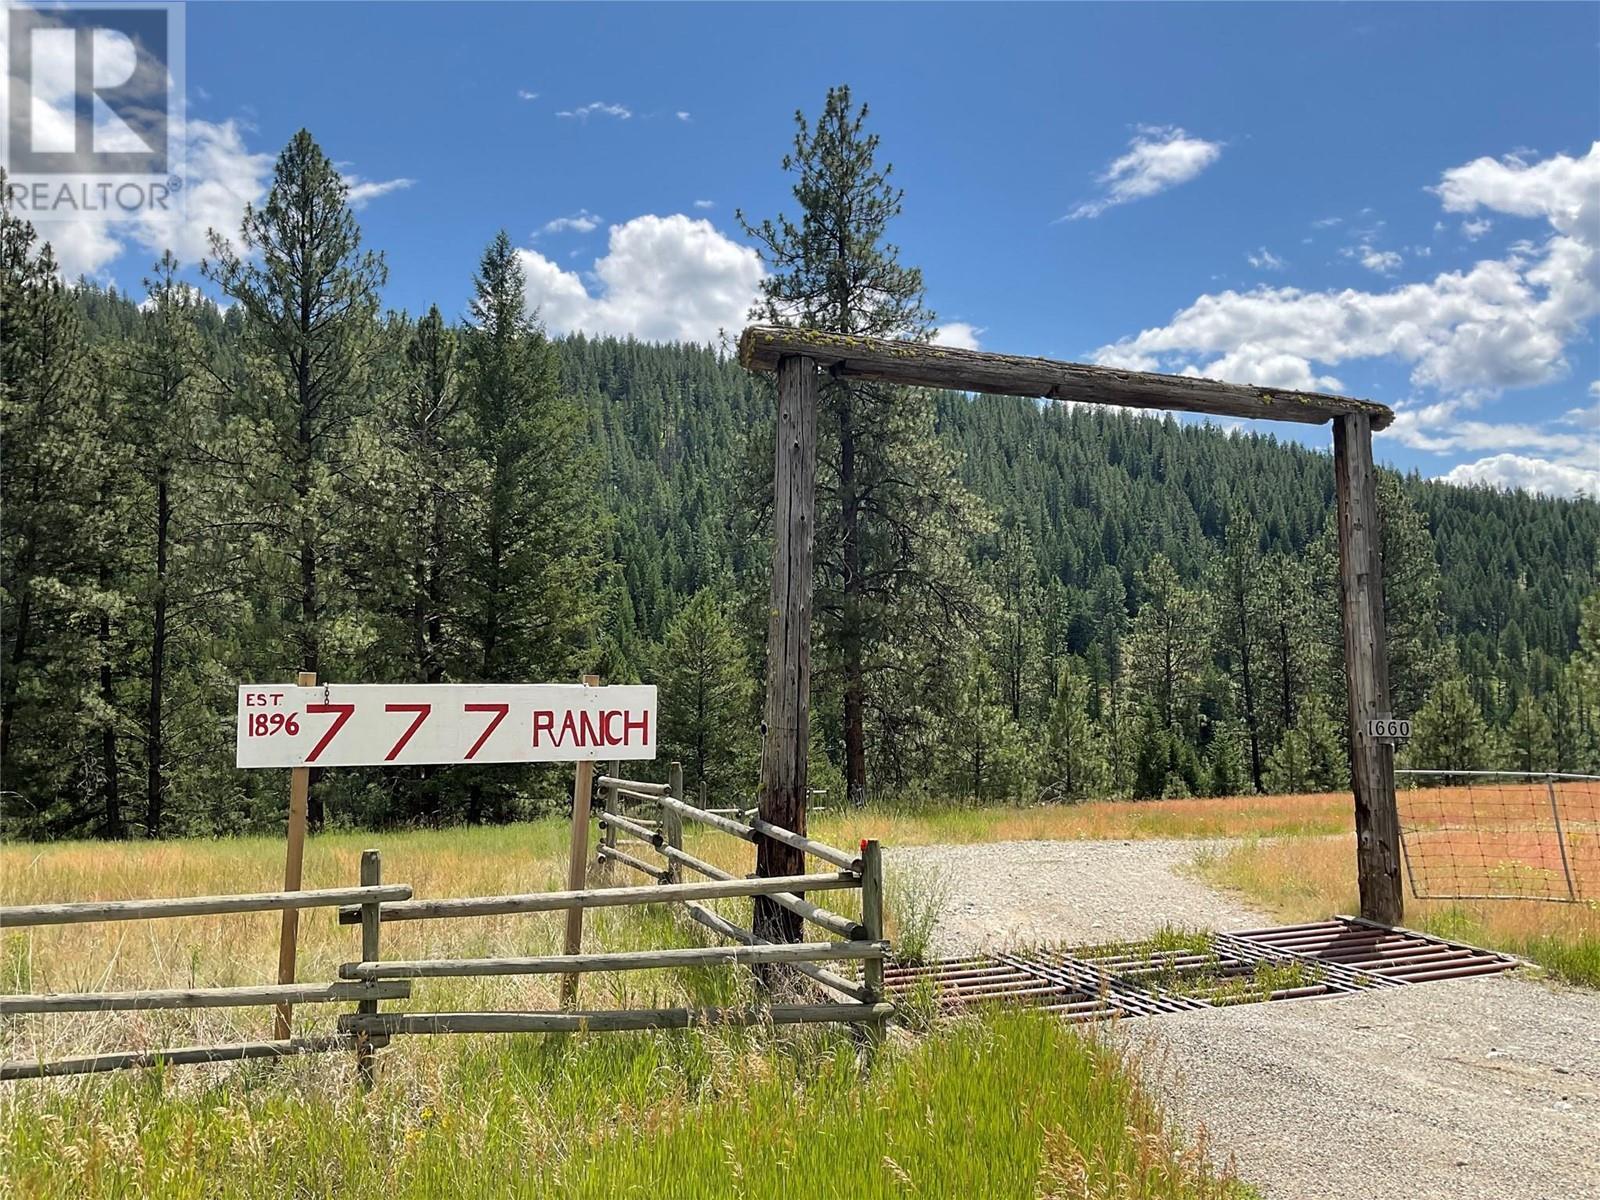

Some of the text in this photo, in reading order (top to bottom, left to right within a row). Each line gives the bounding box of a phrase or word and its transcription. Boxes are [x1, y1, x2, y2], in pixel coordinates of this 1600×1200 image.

[248, 712, 300, 737] 1896
[532, 710, 649, 747] RANCH
[1368, 720, 1410, 736] 1660
